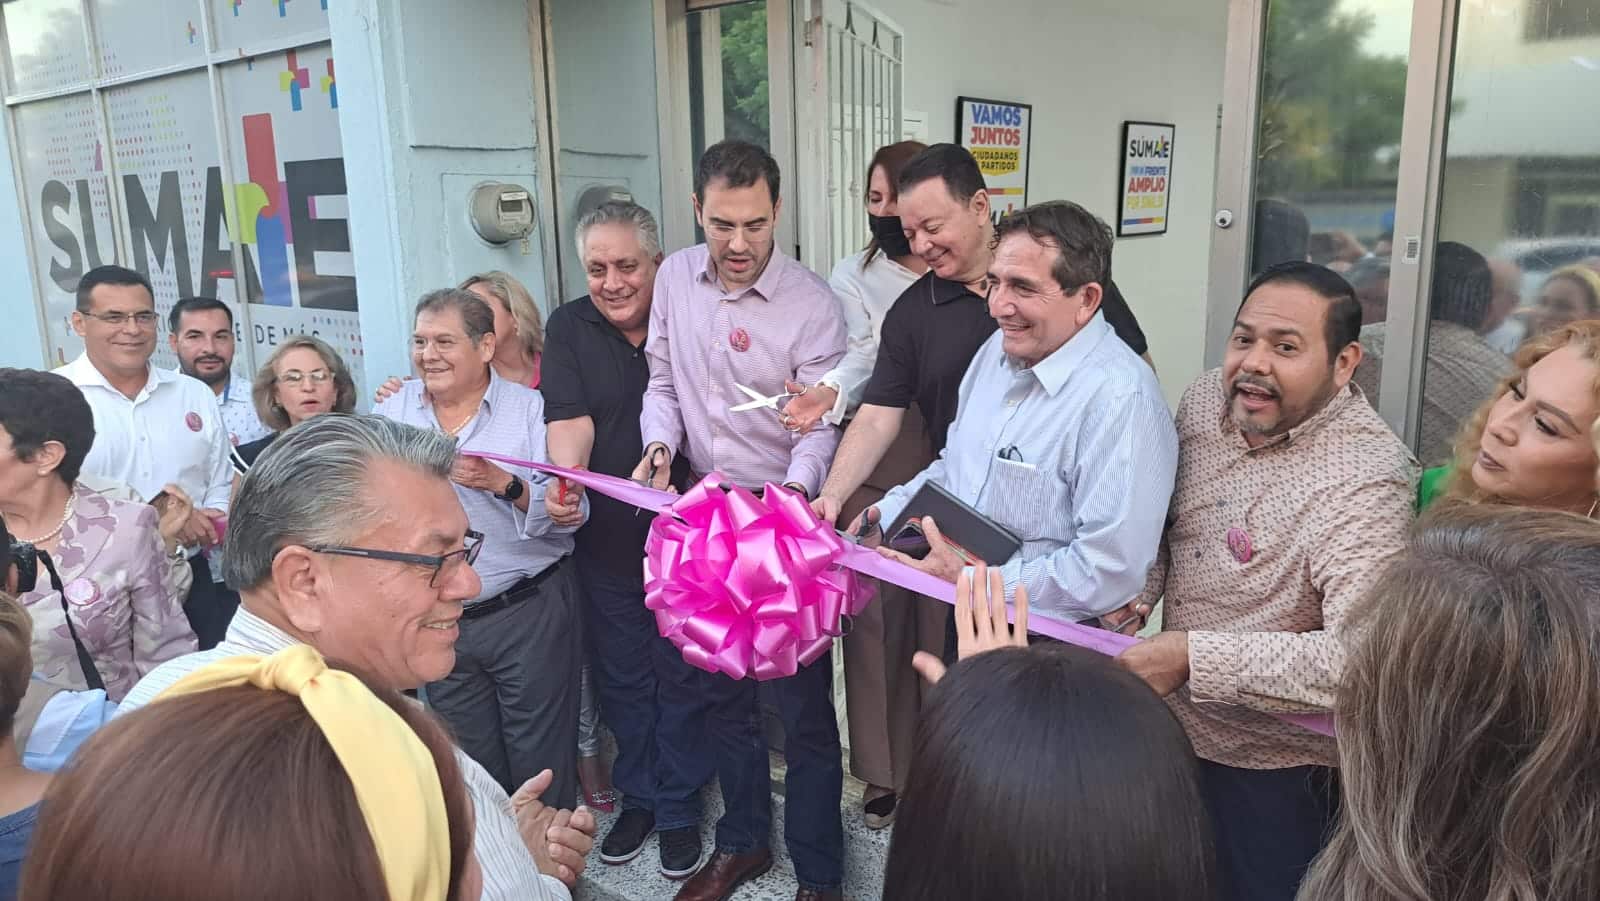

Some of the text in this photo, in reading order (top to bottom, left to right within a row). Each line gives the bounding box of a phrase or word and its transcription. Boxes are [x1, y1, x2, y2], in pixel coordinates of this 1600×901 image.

[971, 104, 1021, 126] VAMOS
[970, 127, 1020, 145] JUNTOS
[981, 161, 1016, 170] PARTIDOS
[1128, 177, 1165, 193] AMPLIO
